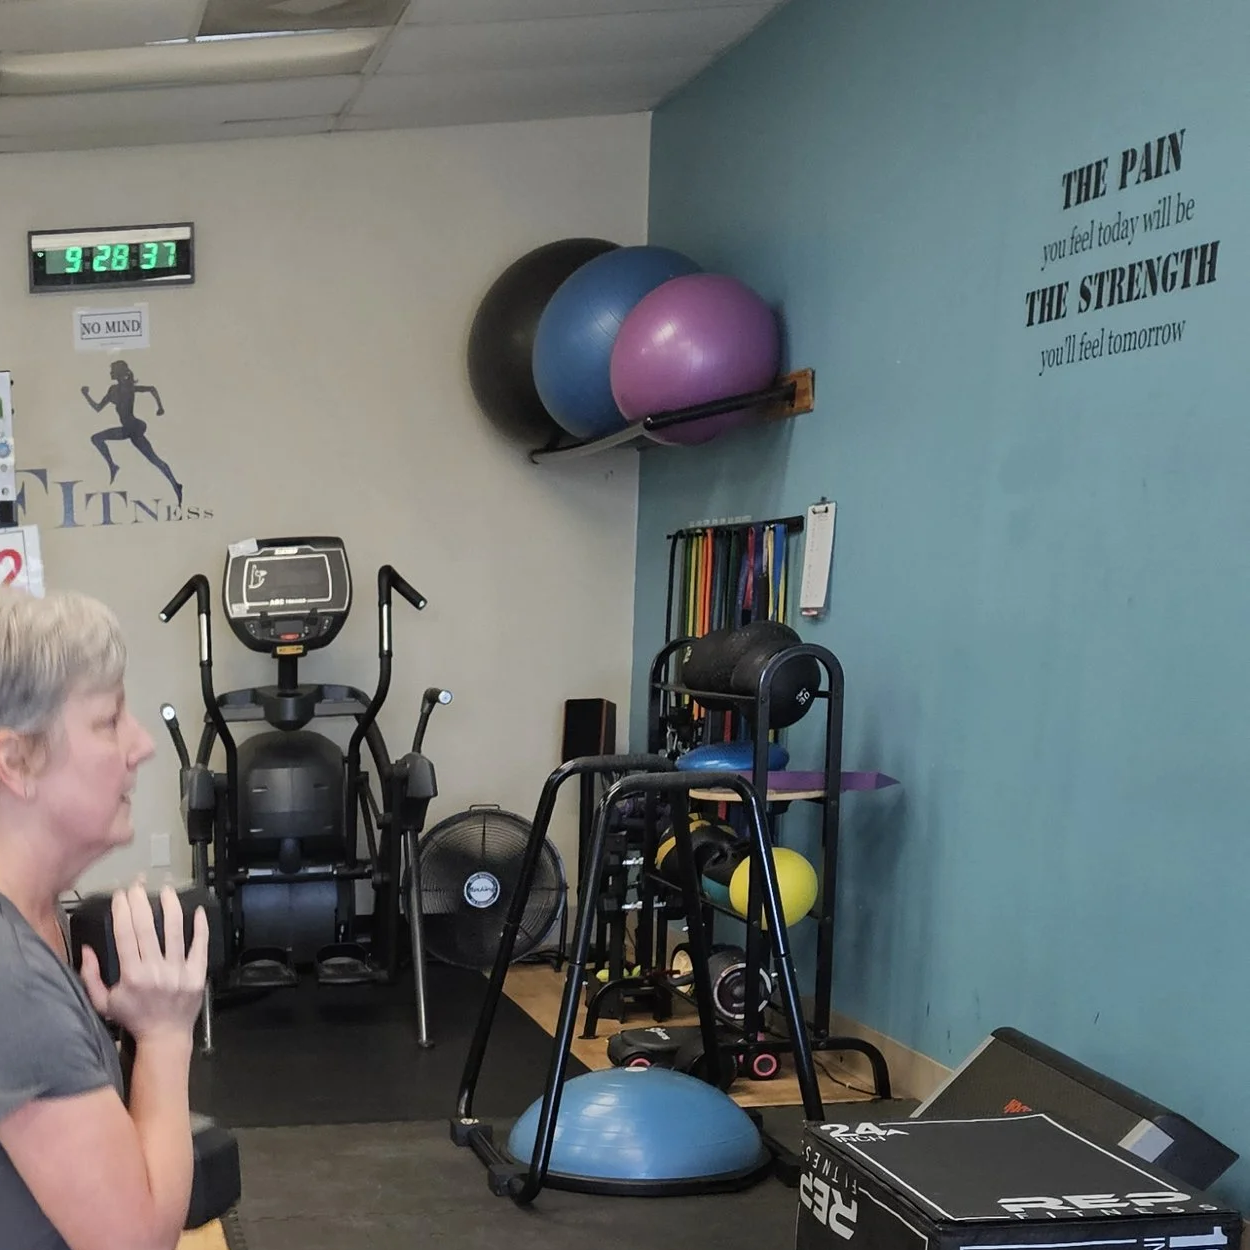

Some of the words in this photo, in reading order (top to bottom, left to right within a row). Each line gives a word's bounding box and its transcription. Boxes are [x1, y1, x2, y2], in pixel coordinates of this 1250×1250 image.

[1062, 157, 1109, 210] THE
[1118, 128, 1186, 190] PAIN
[1040, 239, 1066, 271] you
[1069, 220, 1095, 256] feel
[1098, 211, 1139, 245] today
[1143, 195, 1172, 233] will
[1175, 192, 1195, 224] be
[65, 246, 82, 273] 9
[92, 245, 129, 272] 28
[140, 242, 176, 270] 37
[1025, 281, 1069, 327] THE
[1077, 240, 1220, 314] STRENGTH
[81, 322, 100, 336] NO
[105, 319, 141, 334] MIND
[1039, 334, 1075, 376] you'll
[1079, 328, 1105, 362] feel
[1108, 320, 1186, 355] tomorrow
[820, 1122, 887, 1138] 24
[835, 1135, 887, 1143] INCH
[801, 1140, 859, 1195] FITNES
[800, 1172, 858, 1241] REP
[997, 1191, 1192, 1213] REP
[1014, 1204, 1218, 1220] FITNESS
